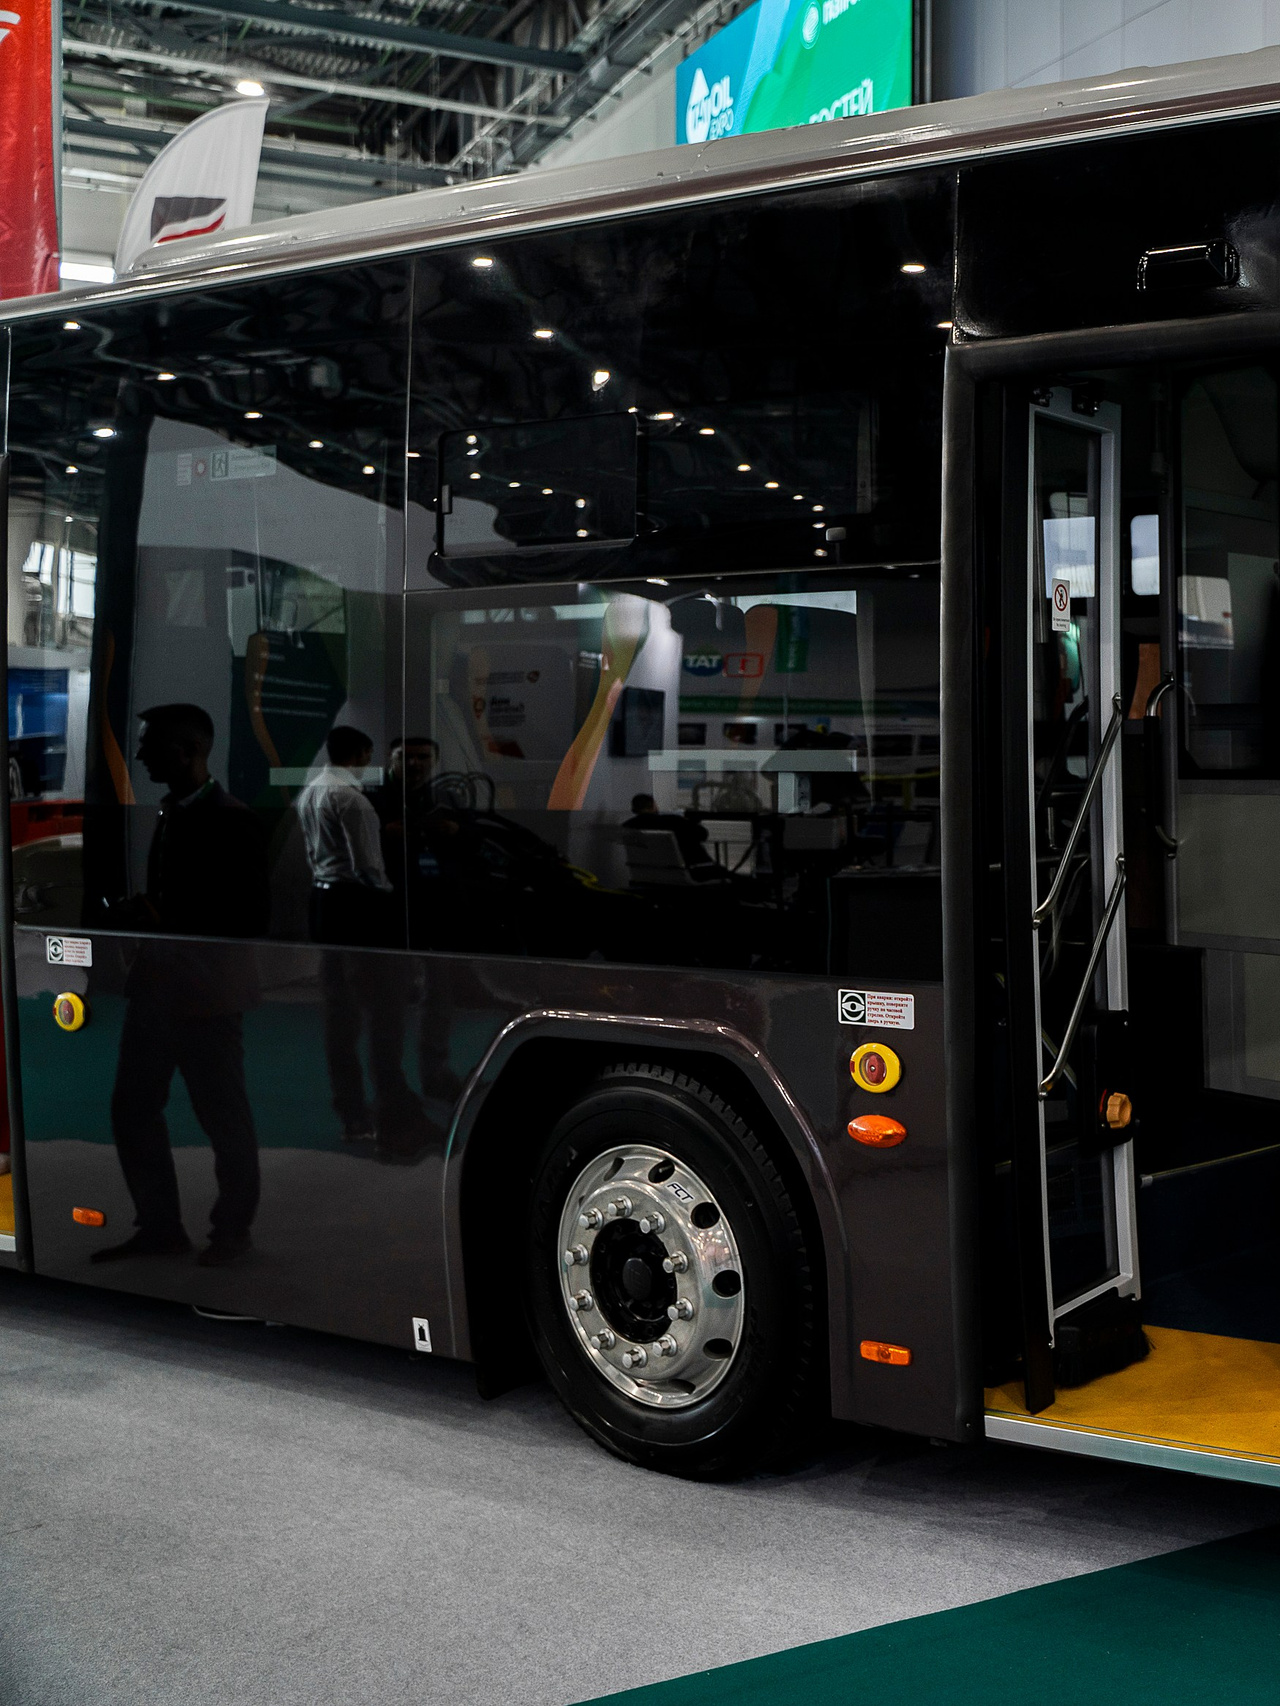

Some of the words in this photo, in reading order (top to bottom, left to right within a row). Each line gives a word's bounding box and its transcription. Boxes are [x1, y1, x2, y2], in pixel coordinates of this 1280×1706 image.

[711, 75, 734, 117] OIL
[709, 107, 734, 141] EXPO
[667, 1183, 694, 1200] FCT
